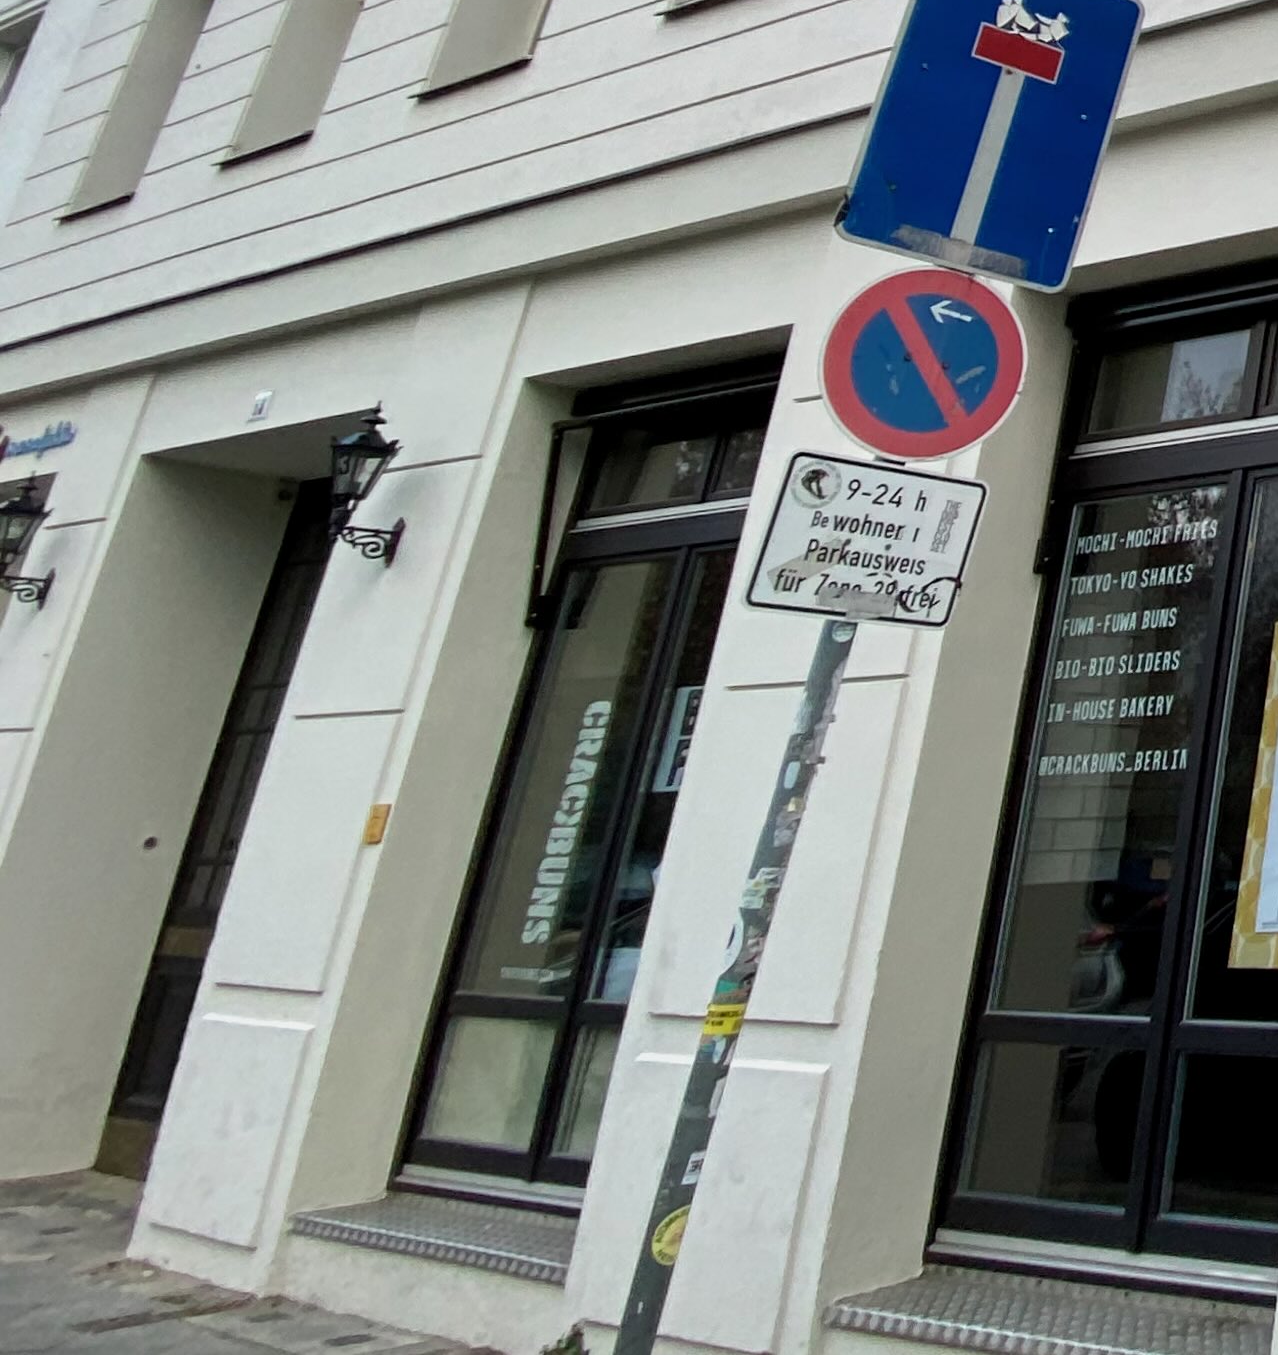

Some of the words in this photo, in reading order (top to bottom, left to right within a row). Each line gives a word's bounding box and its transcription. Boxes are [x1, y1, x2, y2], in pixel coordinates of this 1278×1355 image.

[846, 478, 904, 508] 9-24
[914, 490, 927, 512] h
[1174, 519, 1218, 541] FRIES
[803, 538, 926, 576] Parkausweis
[773, 568, 806, 593] für
[901, 586, 940, 610] frei
[1140, 564, 1194, 588] SHAKES
[1141, 607, 1178, 630] BUNS
[1054, 655, 1114, 679] BIO-BIO
[1118, 650, 1181, 674] SLIDERS
[1047, 698, 1115, 723] IN-HOUSE
[1120, 695, 1174, 718] BAKERY
